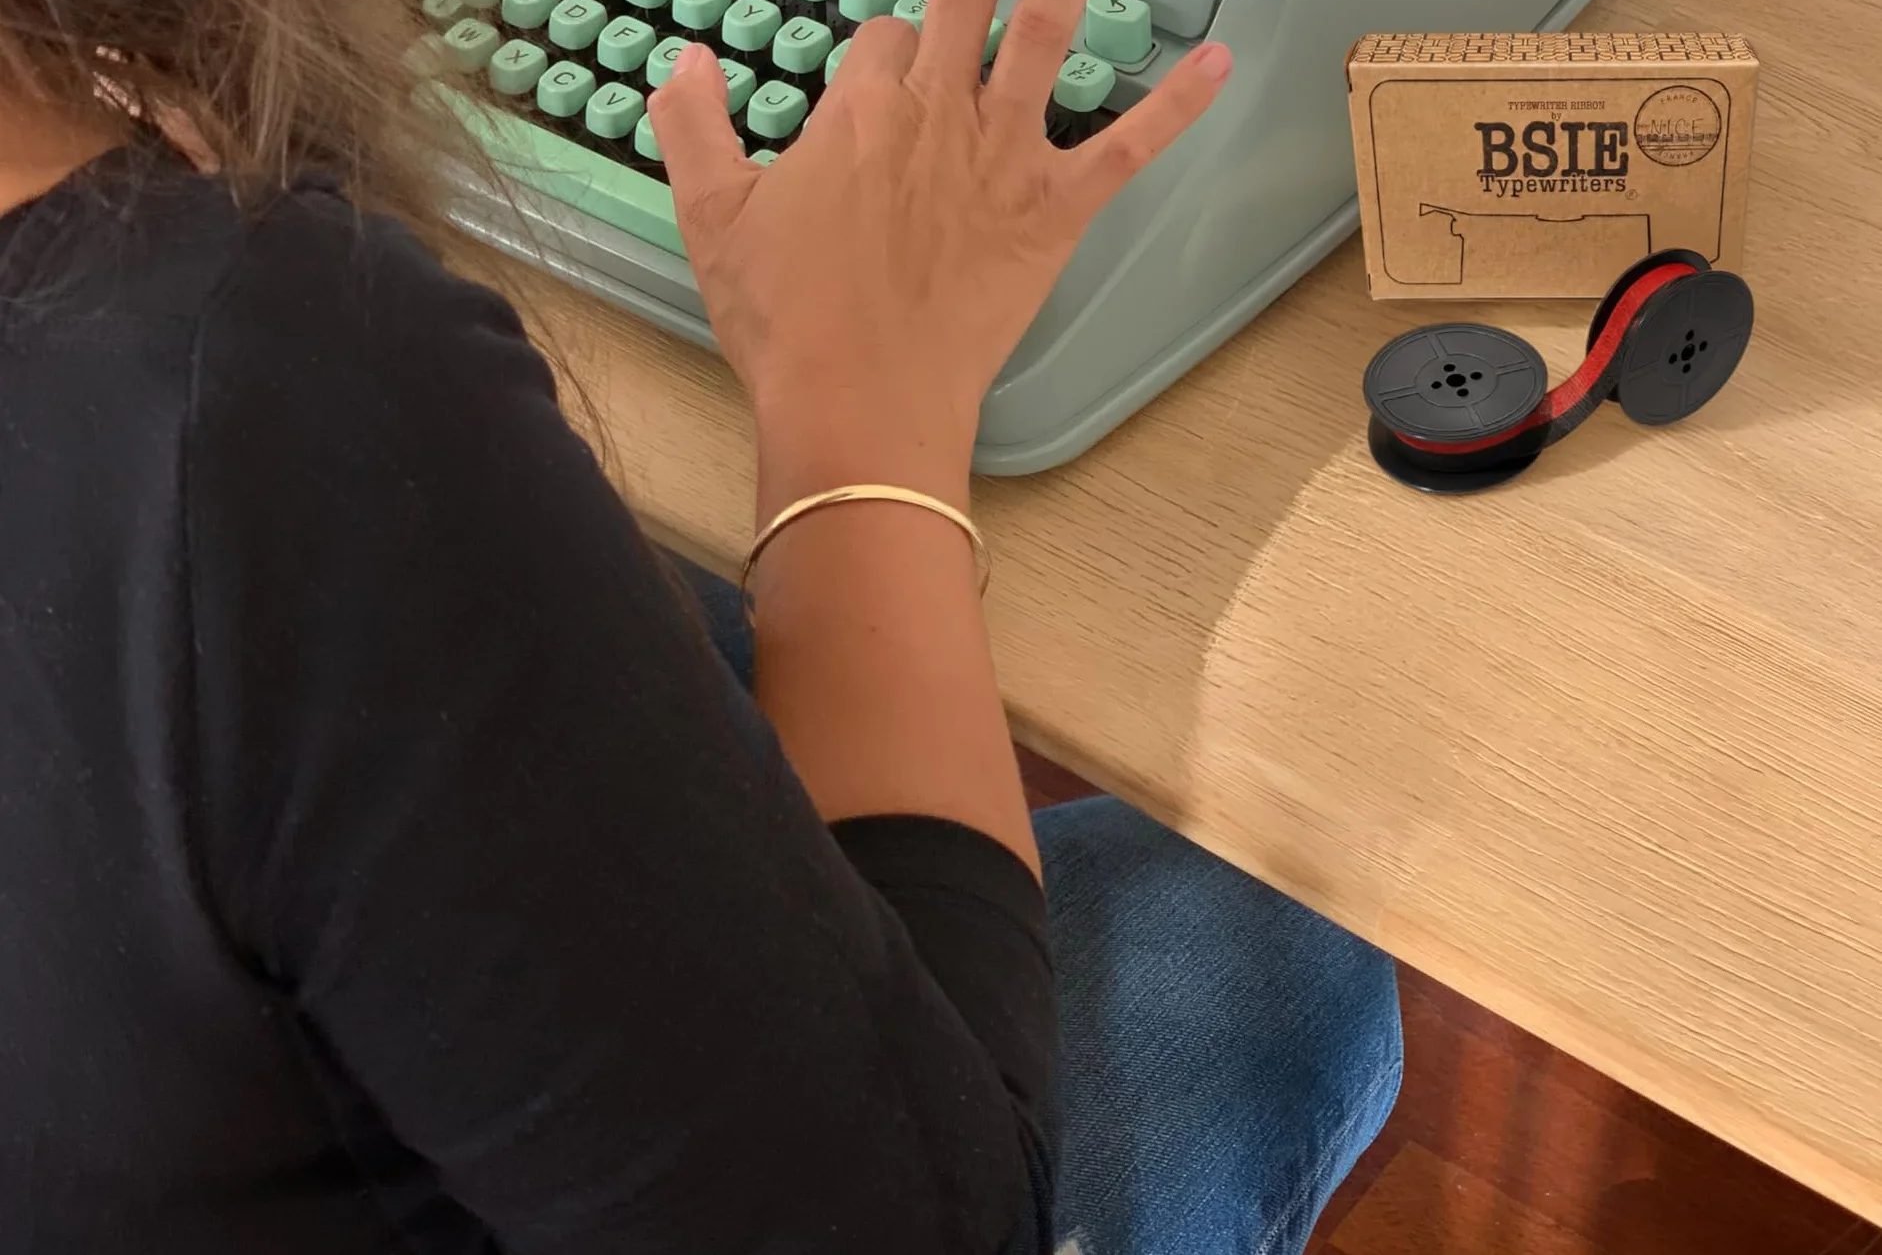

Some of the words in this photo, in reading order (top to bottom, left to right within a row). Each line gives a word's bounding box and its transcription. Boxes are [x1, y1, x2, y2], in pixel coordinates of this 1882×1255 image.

[743, 4, 763, 19] Y
[790, 26, 814, 41] U
[457, 27, 483, 42] W
[504, 49, 529, 64] X
[553, 71, 577, 86] C
[606, 91, 627, 106] V
[565, 4, 588, 18] D
[613, 27, 638, 38] F
[765, 95, 789, 106] J
[1507, 100, 1568, 111] TYPEWRITER
[1570, 100, 1606, 111] RIBBON
[1660, 93, 1699, 105] FRANCE
[1551, 111, 1562, 122] by
[1650, 118, 1704, 136] NICE
[1474, 121, 1630, 178] BSIE
[1480, 173, 1627, 198] Typewriters
